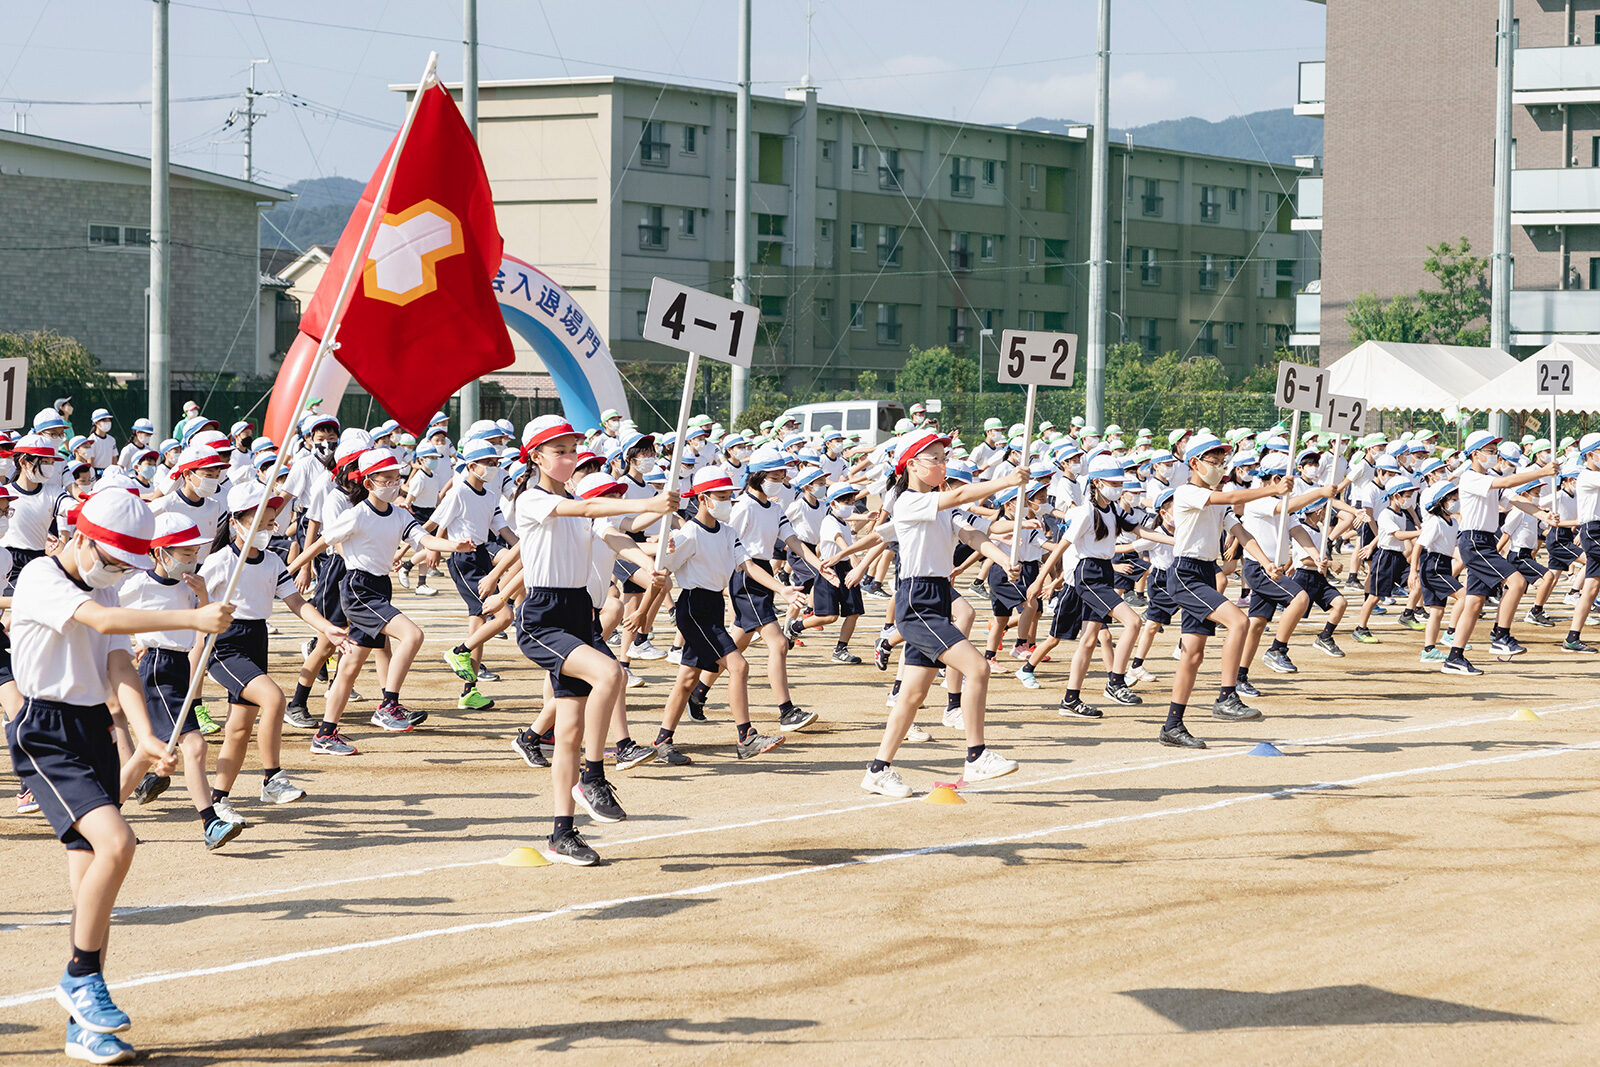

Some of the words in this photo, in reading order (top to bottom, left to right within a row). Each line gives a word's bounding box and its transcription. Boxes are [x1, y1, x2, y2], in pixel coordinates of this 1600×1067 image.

[661, 292, 744, 357] 4-1
[1007, 336, 1069, 380] 5-2
[1283, 367, 1324, 408] 6-1
[1540, 363, 1570, 391] 2-2
[1328, 398, 1362, 432] 1-2
[1074, 704, 1086, 713] N
[71, 987, 92, 1009] N
[76, 1029, 97, 1049] N
